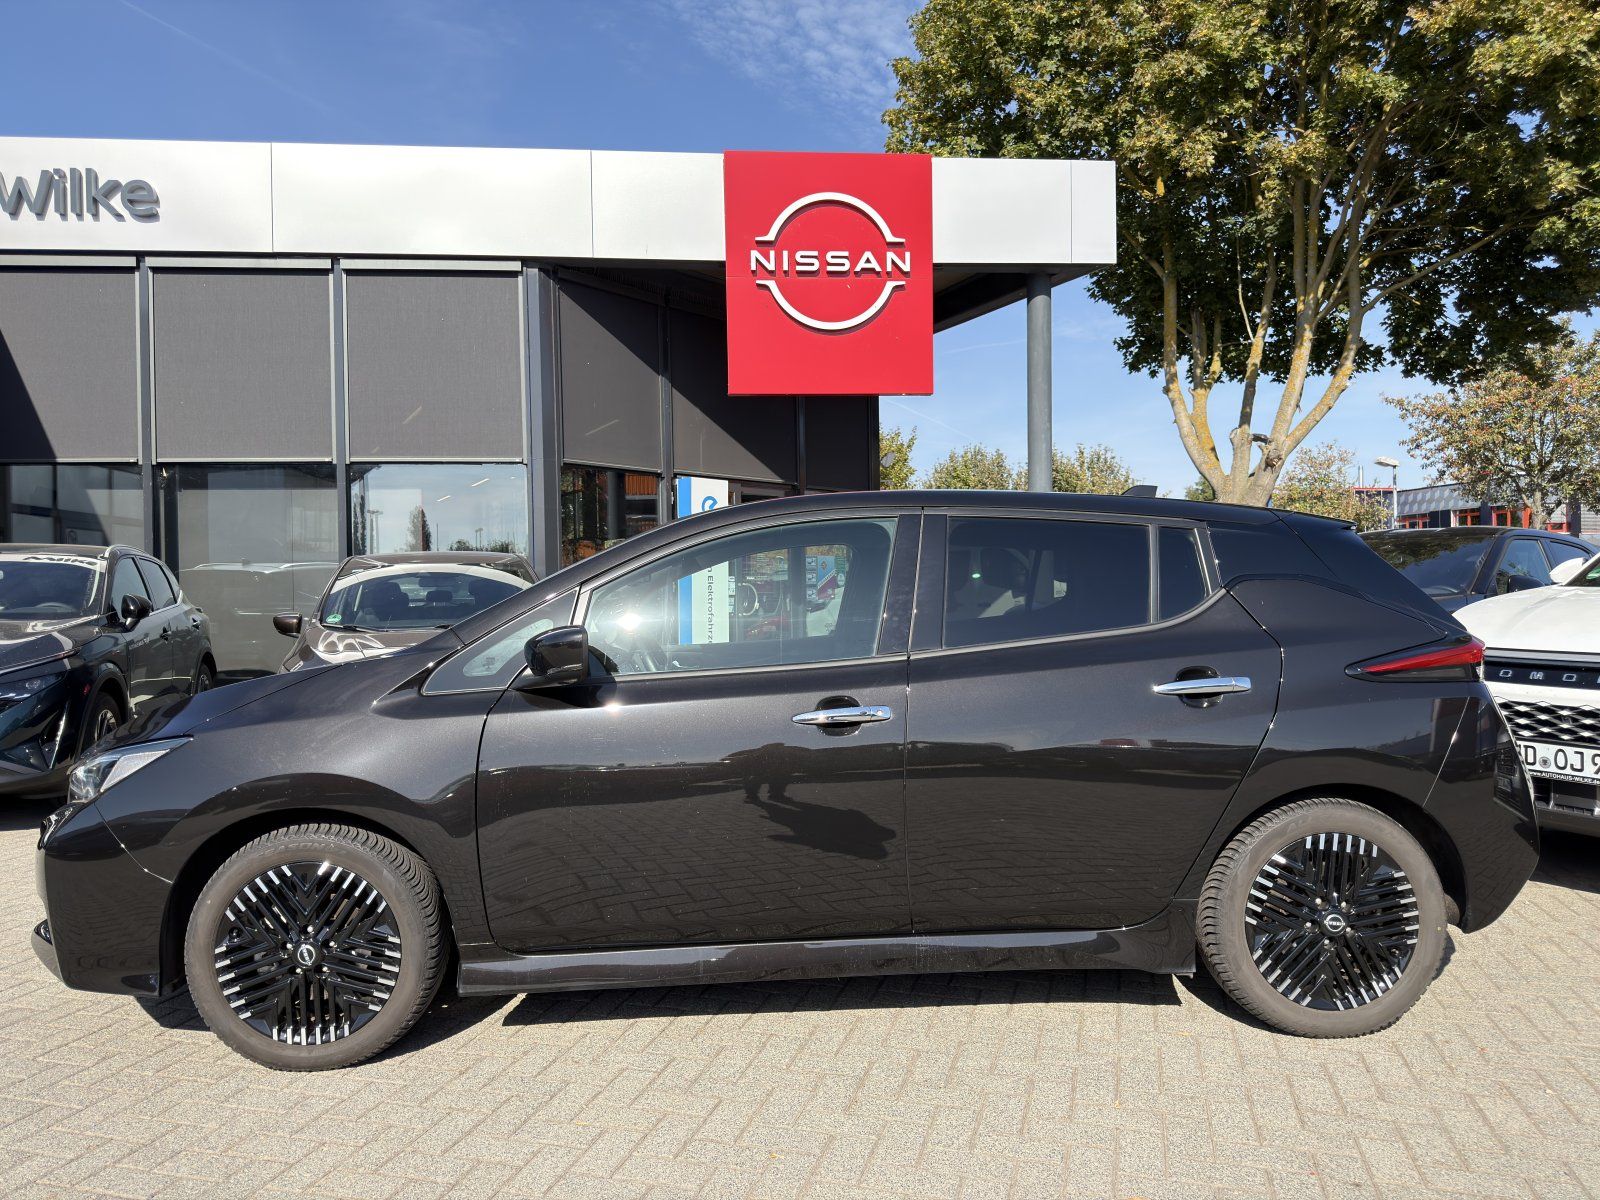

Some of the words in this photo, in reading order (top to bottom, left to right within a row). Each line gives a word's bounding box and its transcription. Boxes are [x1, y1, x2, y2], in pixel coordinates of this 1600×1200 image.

[0, 167, 160, 222] Wilke
[750, 249, 911, 276] NISSAN
[1517, 743, 1537, 766] D
